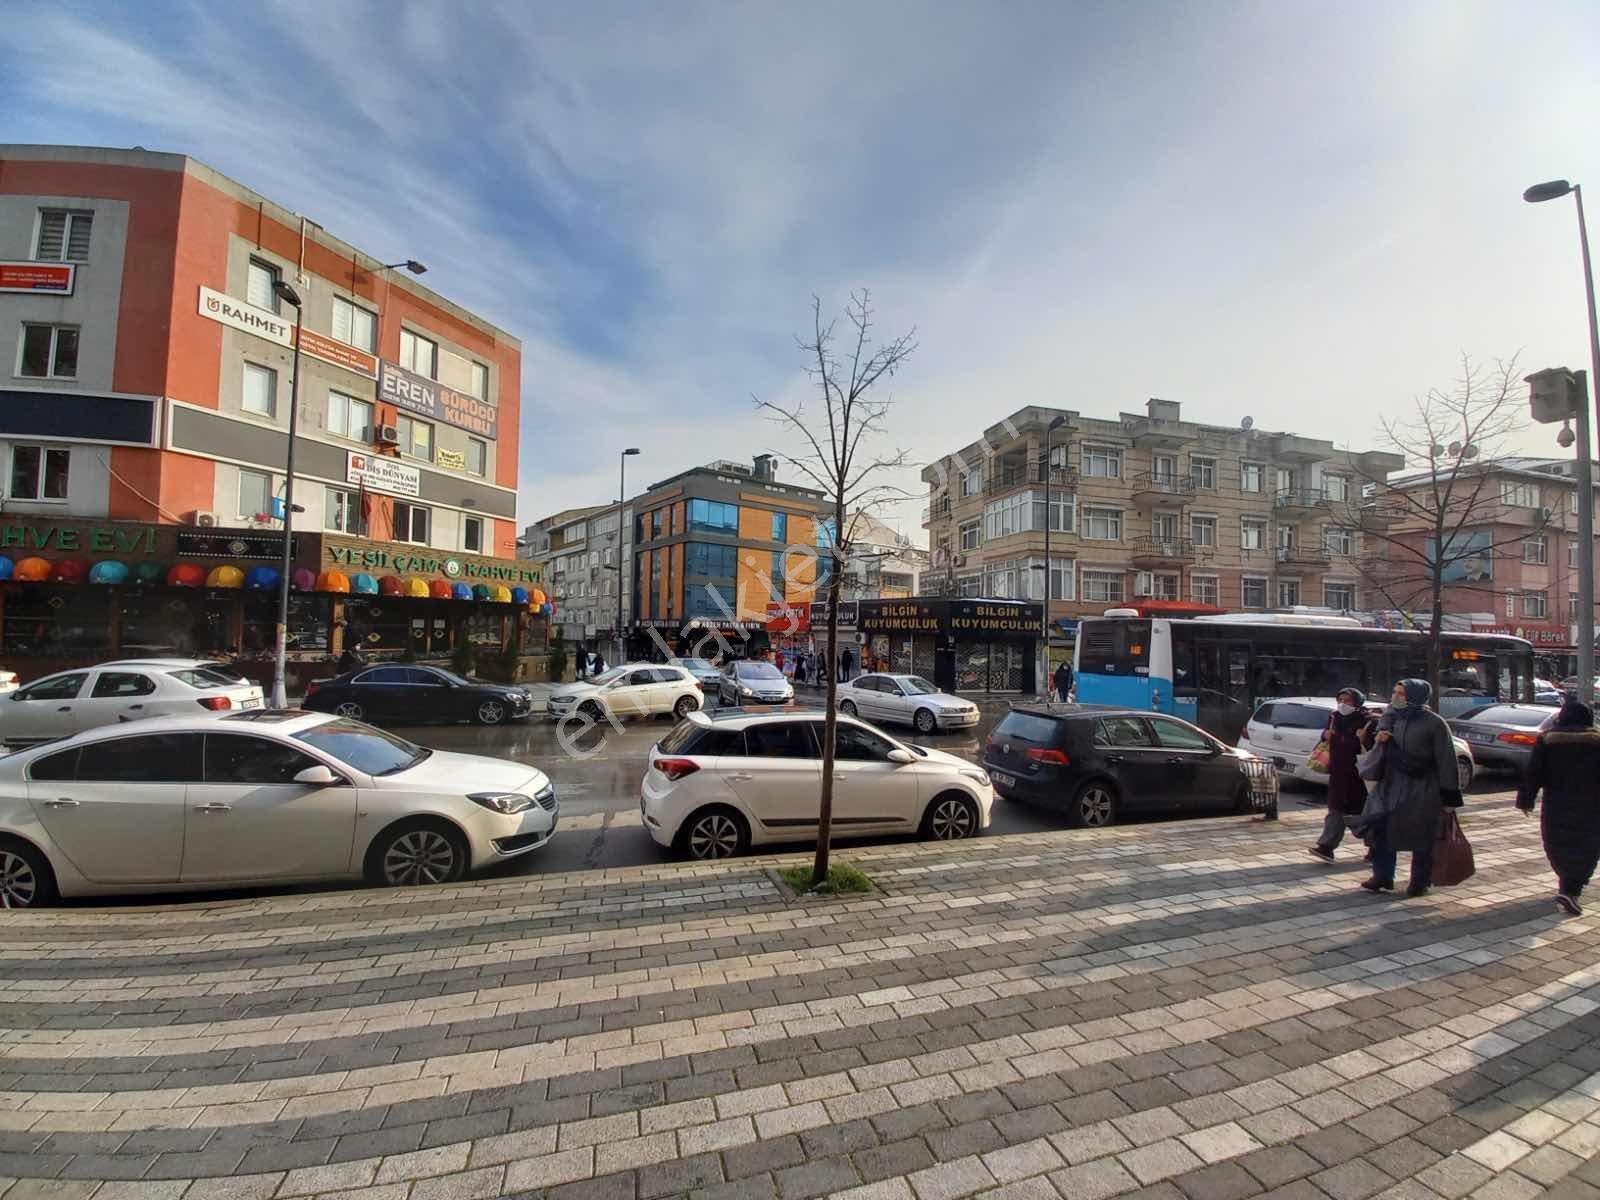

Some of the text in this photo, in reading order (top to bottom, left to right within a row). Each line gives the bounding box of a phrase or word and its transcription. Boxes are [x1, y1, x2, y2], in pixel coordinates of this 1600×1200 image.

[222, 303, 286, 338] RAHMET
[382, 372, 434, 407] EREN
[464, 563, 517, 581] KAHVE
[881, 603, 918, 617] BİLGİN
[976, 605, 1019, 617] BİLGİN
[864, 618, 939, 630] KUYUMCULUK
[952, 618, 1041, 631] KUYUMCULUK
